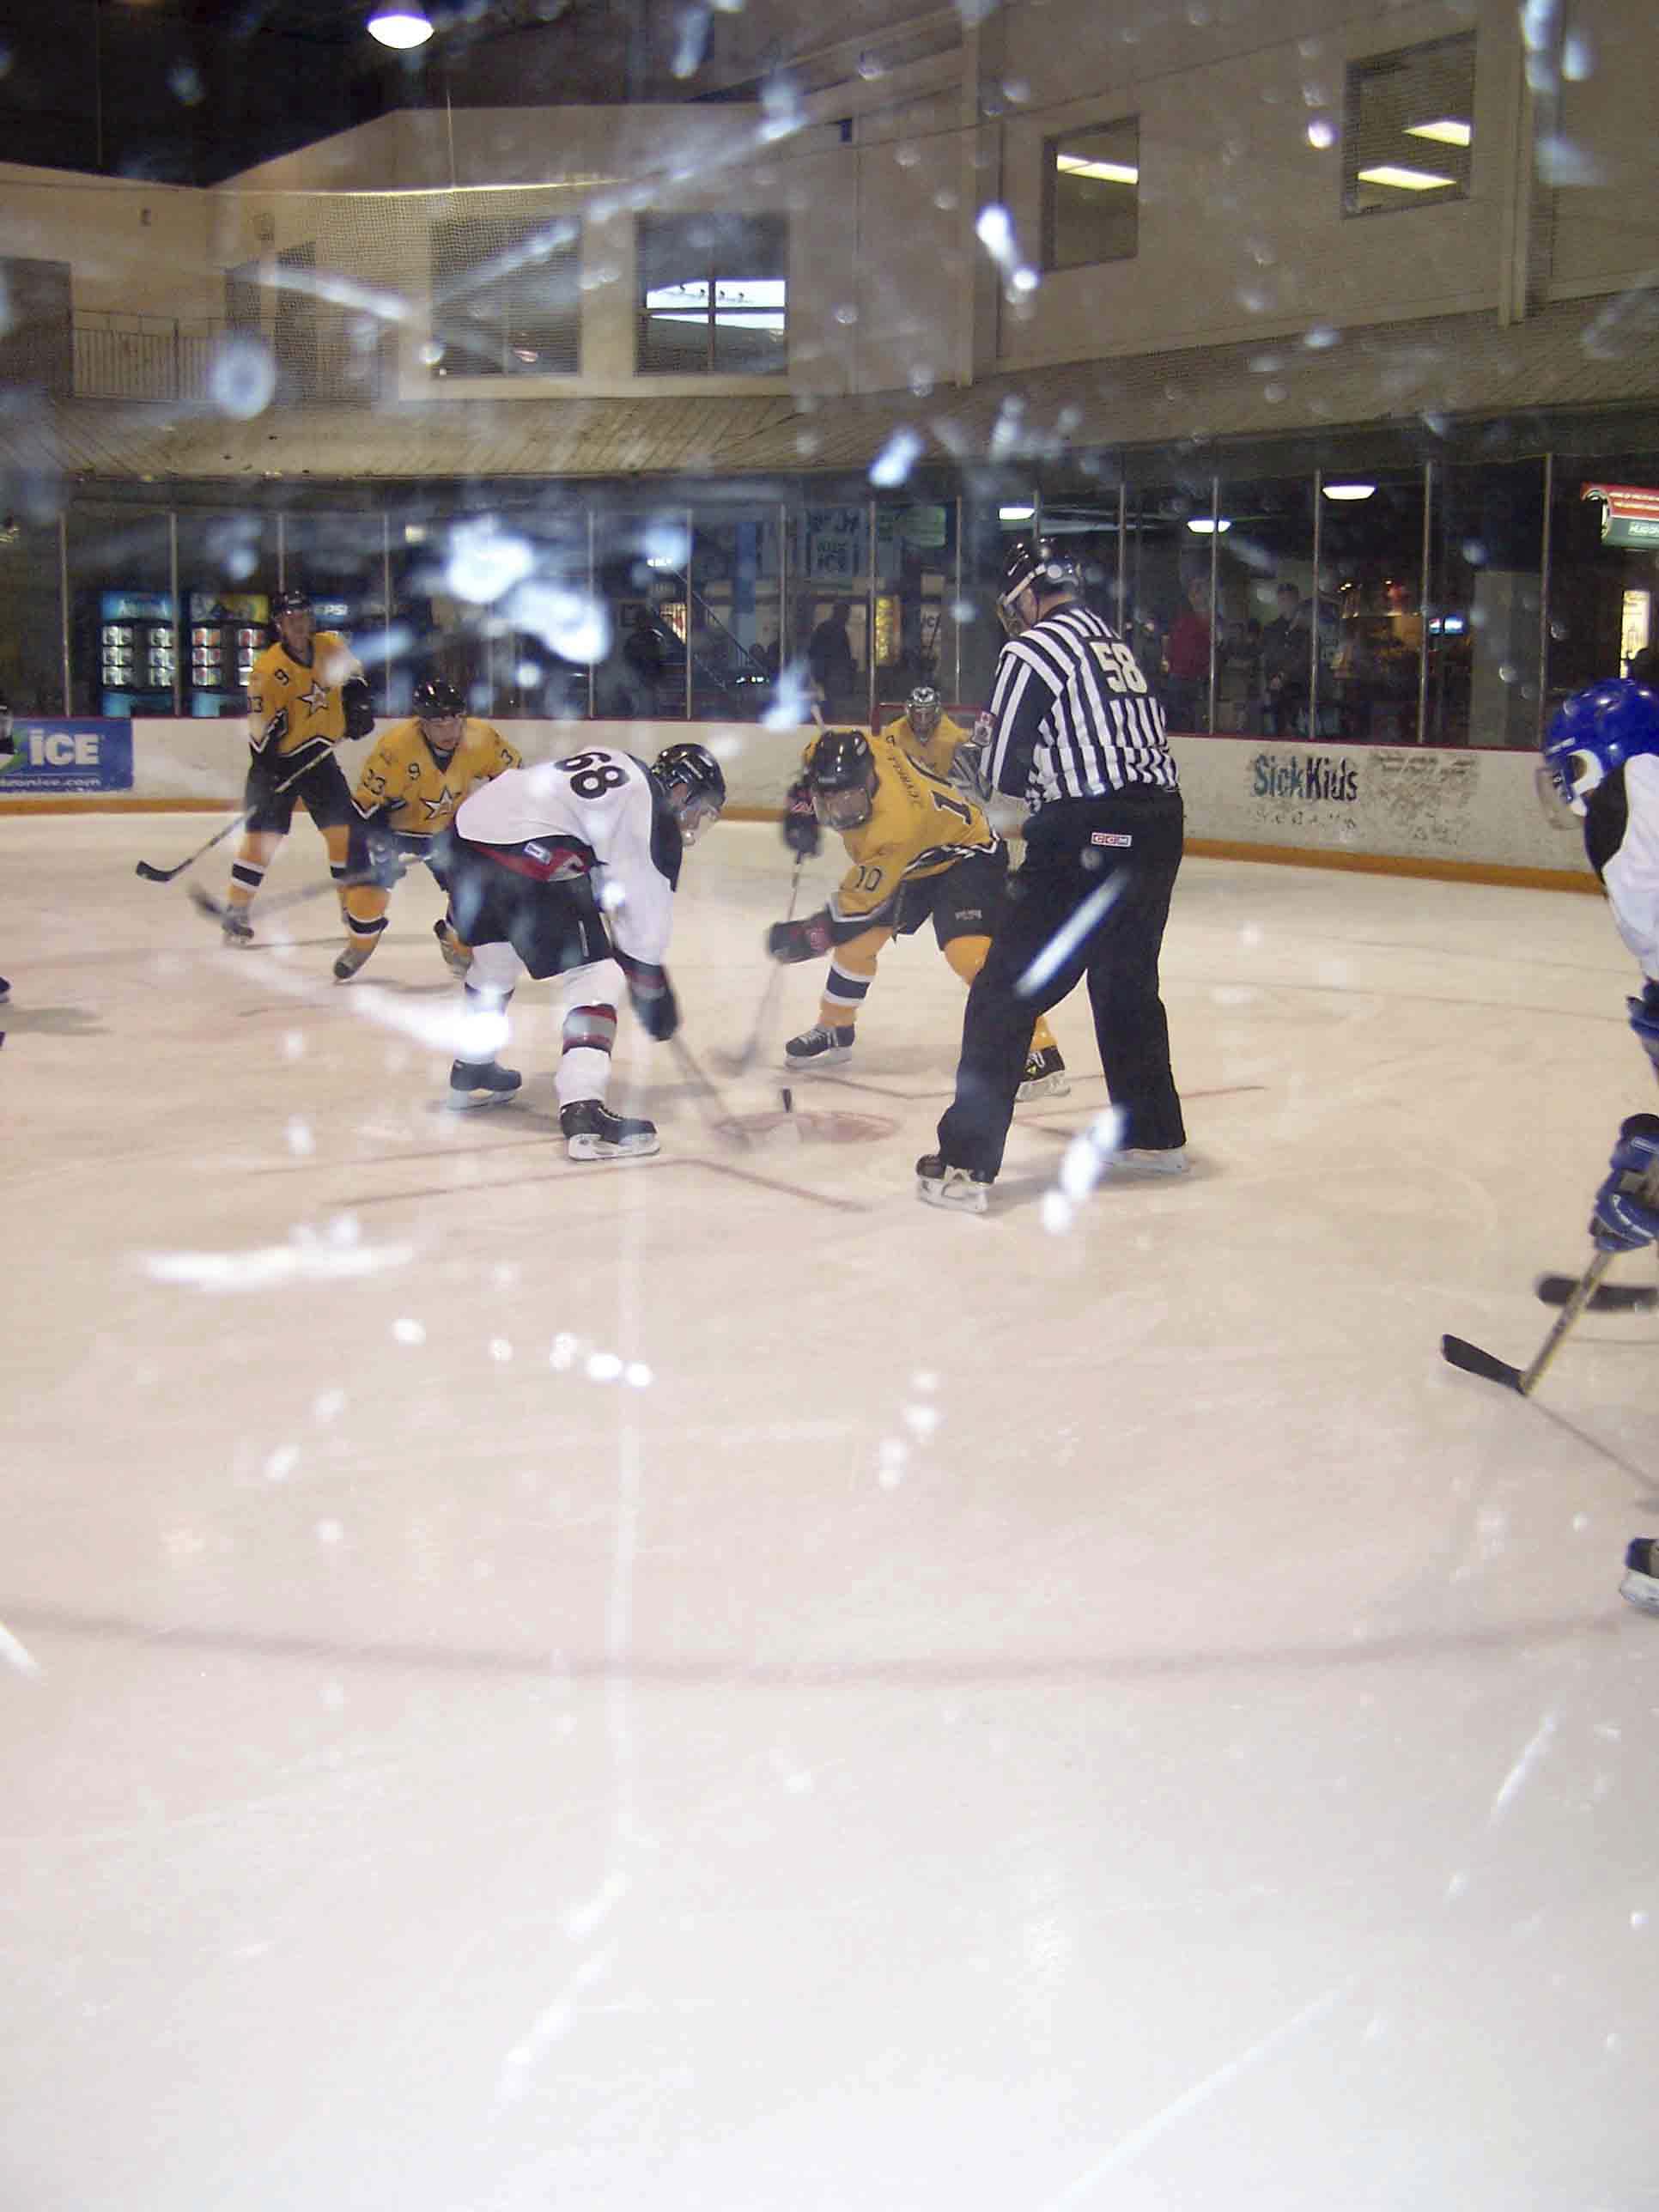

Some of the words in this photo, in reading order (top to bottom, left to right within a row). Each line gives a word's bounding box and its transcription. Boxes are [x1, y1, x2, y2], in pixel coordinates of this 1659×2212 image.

[275, 668, 289, 686] 9
[1089, 641, 1148, 694] 58
[408, 763, 422, 781] 9
[553, 751, 631, 799] 68
[1092, 834, 1131, 847] CCM
[854, 864, 883, 891] 10
